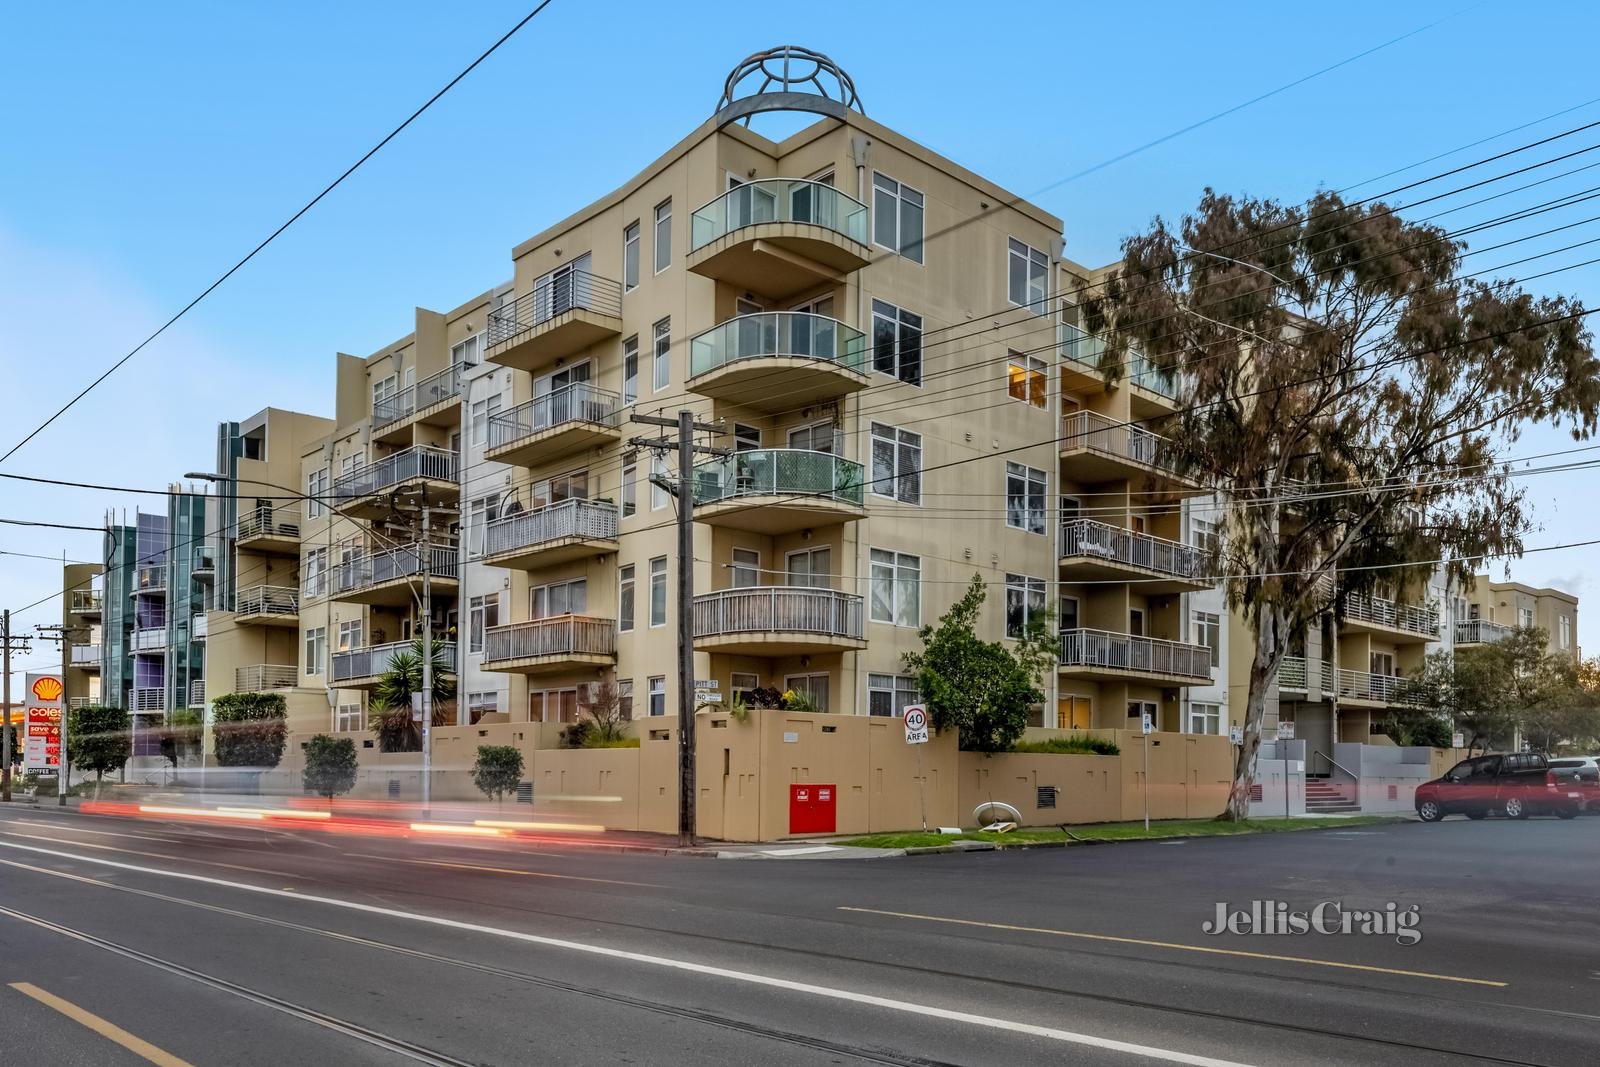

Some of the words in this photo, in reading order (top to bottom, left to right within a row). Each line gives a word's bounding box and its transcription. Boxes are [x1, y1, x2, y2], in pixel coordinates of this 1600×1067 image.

[29, 708, 61, 716] coles
[908, 714, 922, 724] 40
[907, 732, 927, 740] AREA
